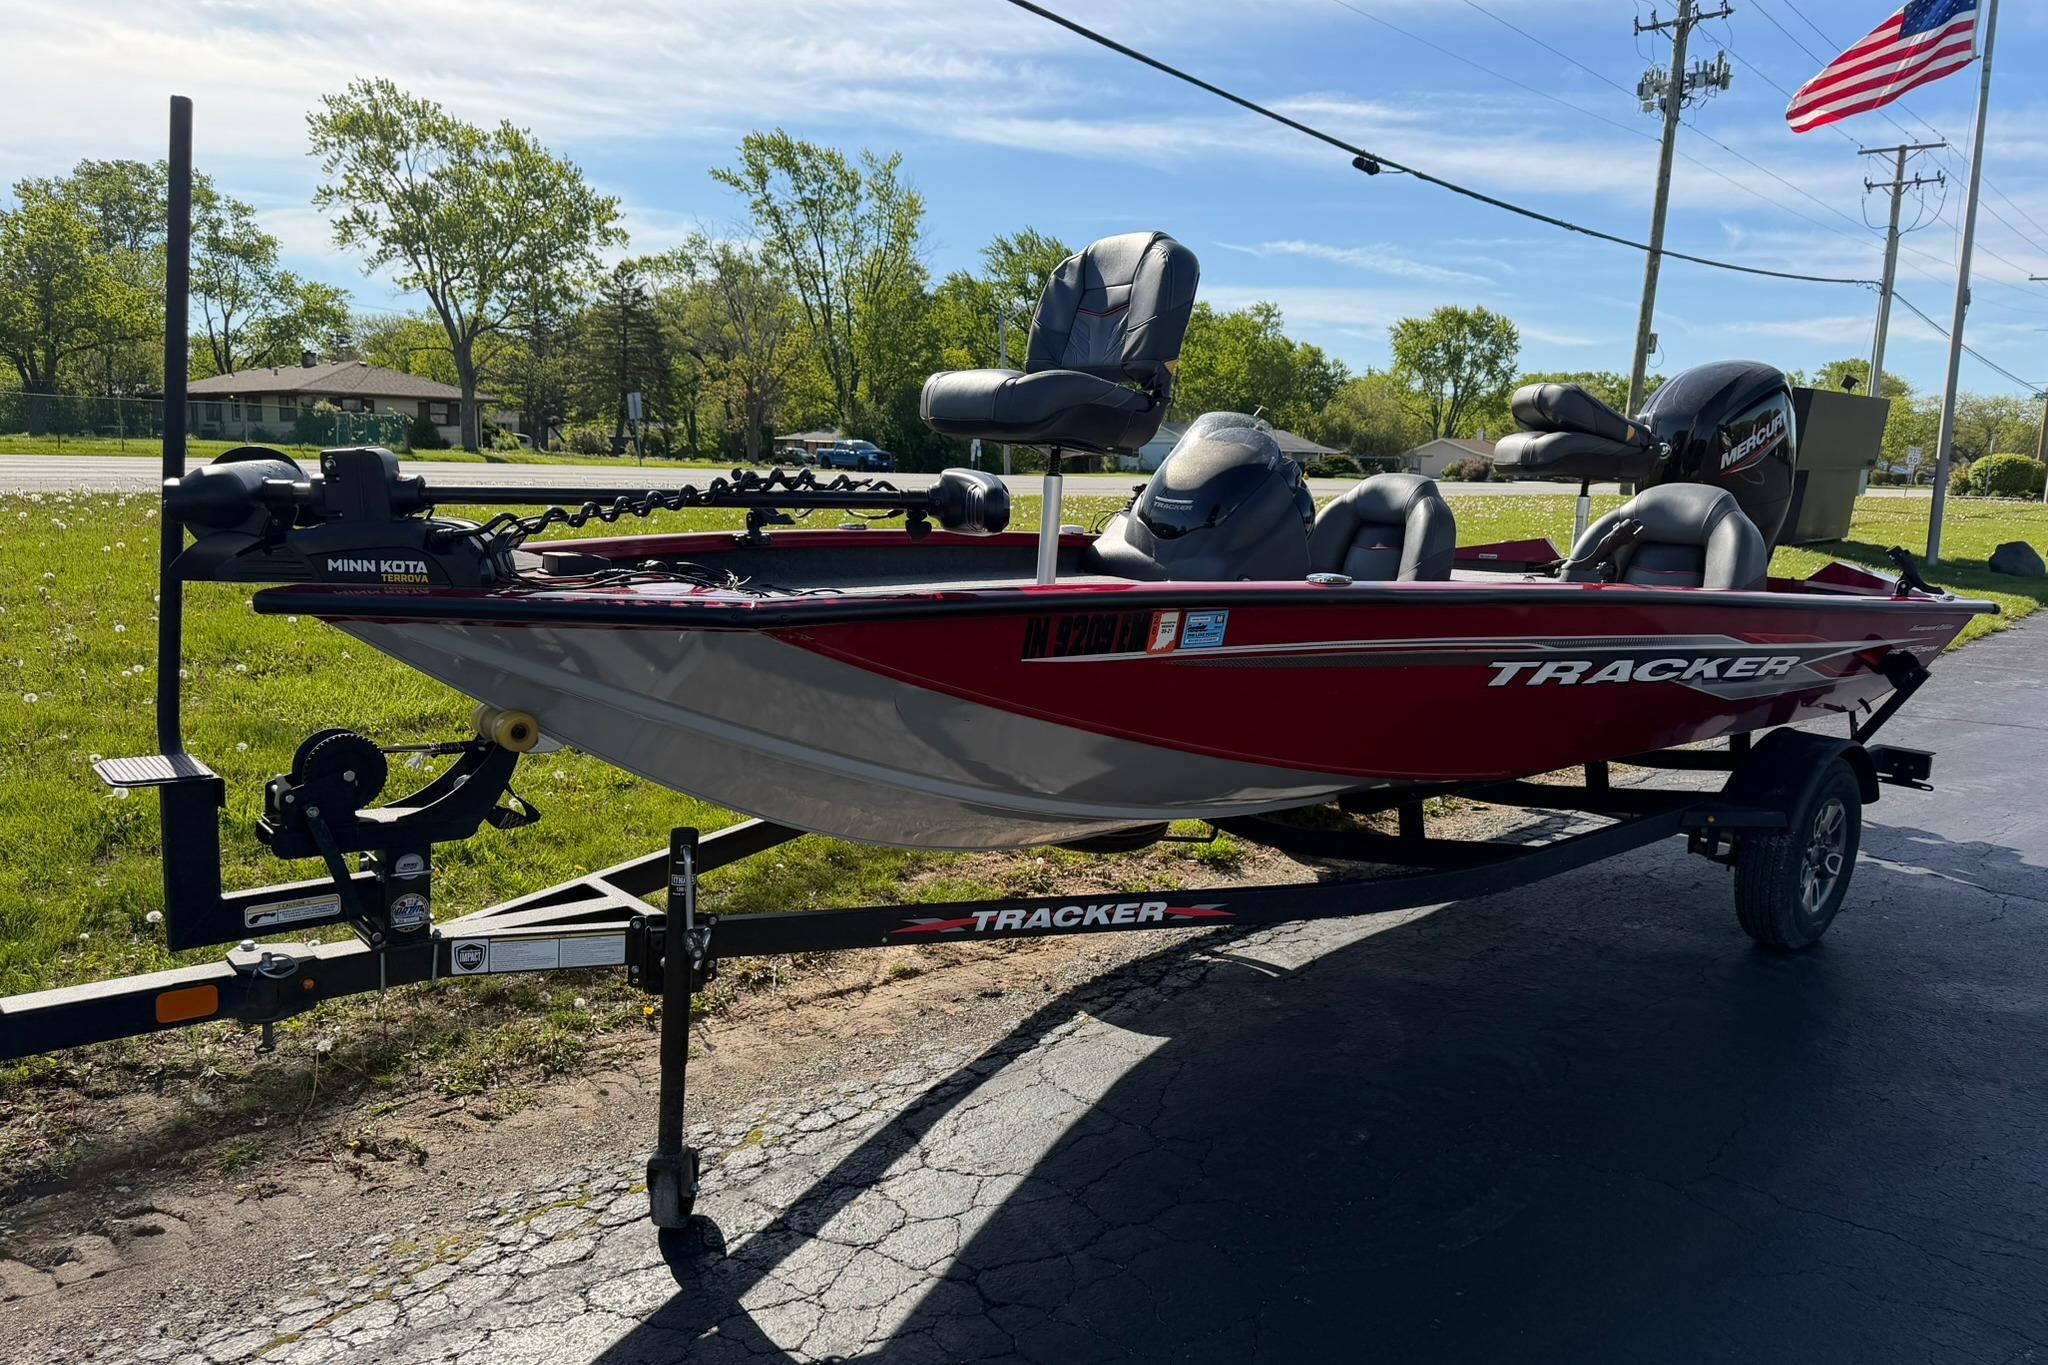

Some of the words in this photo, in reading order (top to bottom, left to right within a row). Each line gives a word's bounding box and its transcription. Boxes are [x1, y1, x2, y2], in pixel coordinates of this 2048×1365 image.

[1720, 410, 1787, 470] MERCURY
[1154, 501, 1193, 511] TRACKER
[327, 558, 376, 572] MINN
[380, 559, 428, 574] KOTA
[381, 573, 429, 583] TERROVA
[1023, 616, 1052, 659] IN
[1487, 654, 1802, 688] TRACKER
[971, 901, 1169, 932] TRACKER
[459, 951, 482, 963] IMPACT
